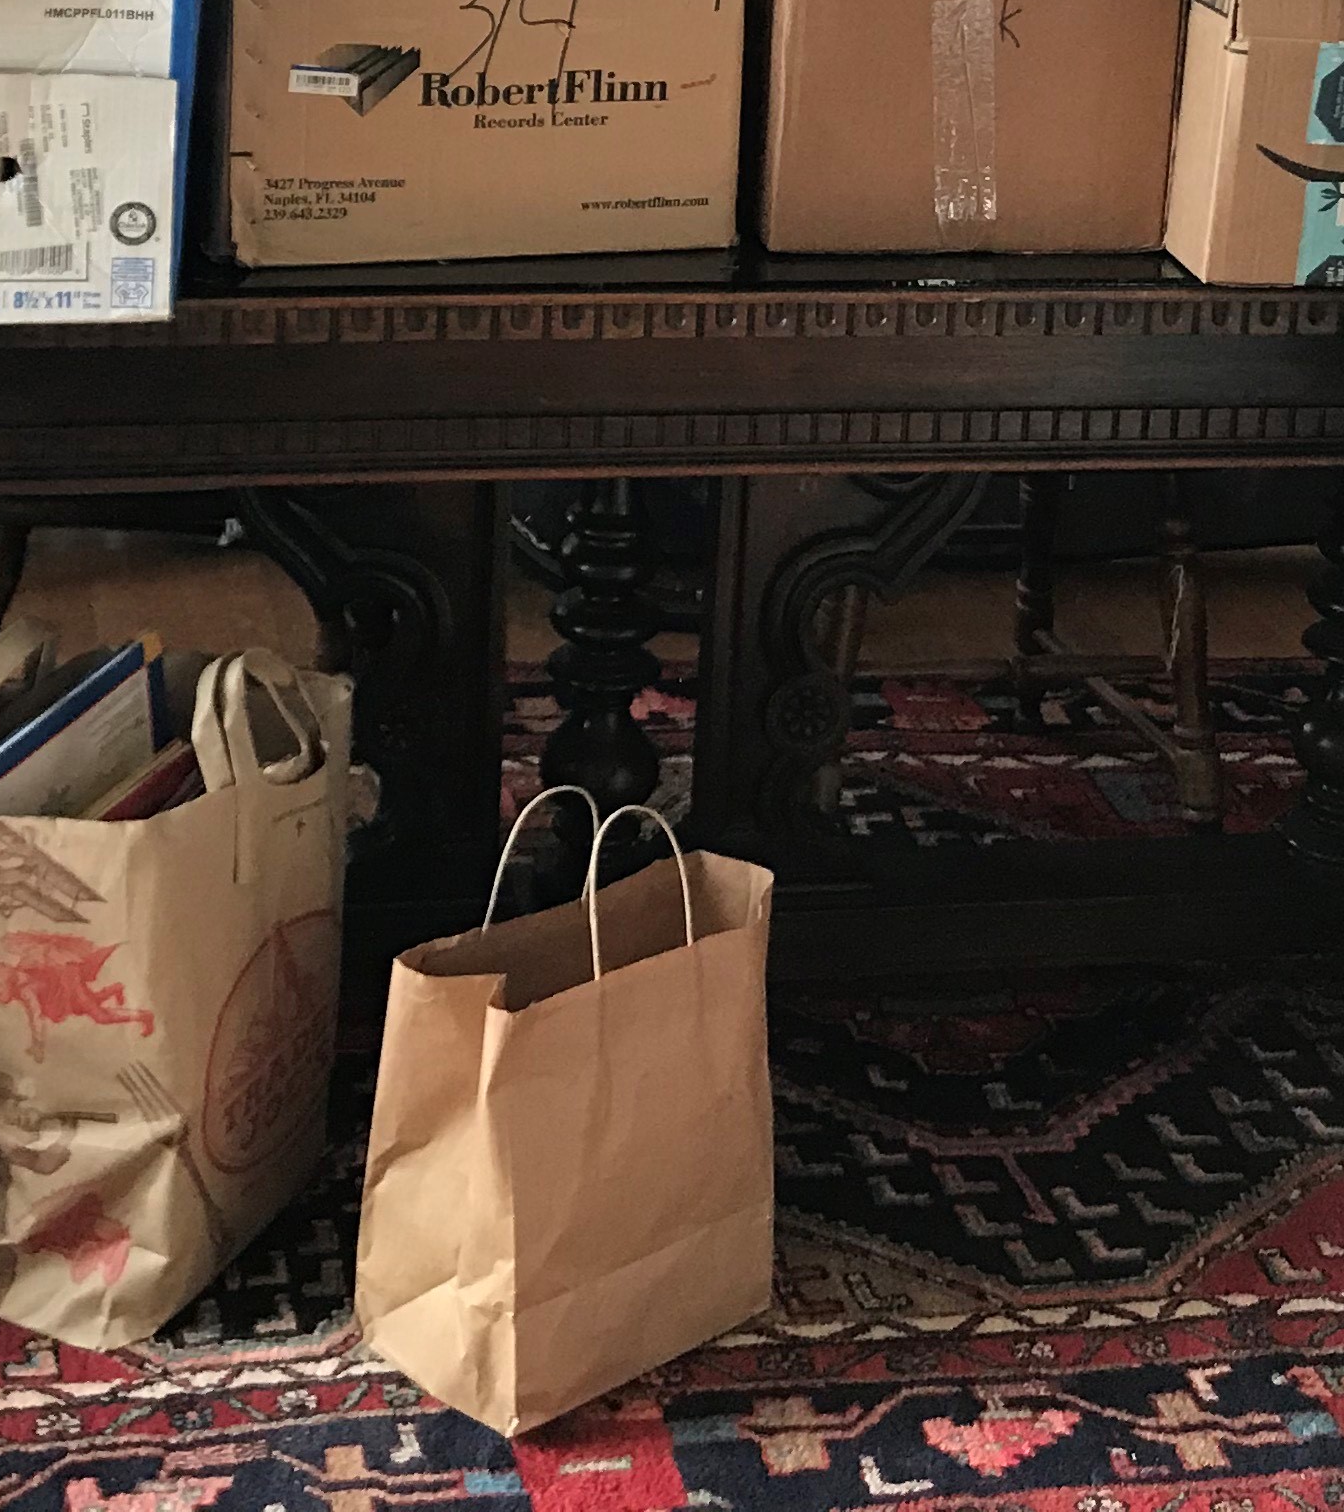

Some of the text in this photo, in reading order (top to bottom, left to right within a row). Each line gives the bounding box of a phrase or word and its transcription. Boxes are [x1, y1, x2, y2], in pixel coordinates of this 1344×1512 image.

[473, 112, 609, 129] Records Center
[81, 117, 93, 154] Staples
[297, 177, 355, 193] Progress
[358, 176, 406, 189] Avenue
